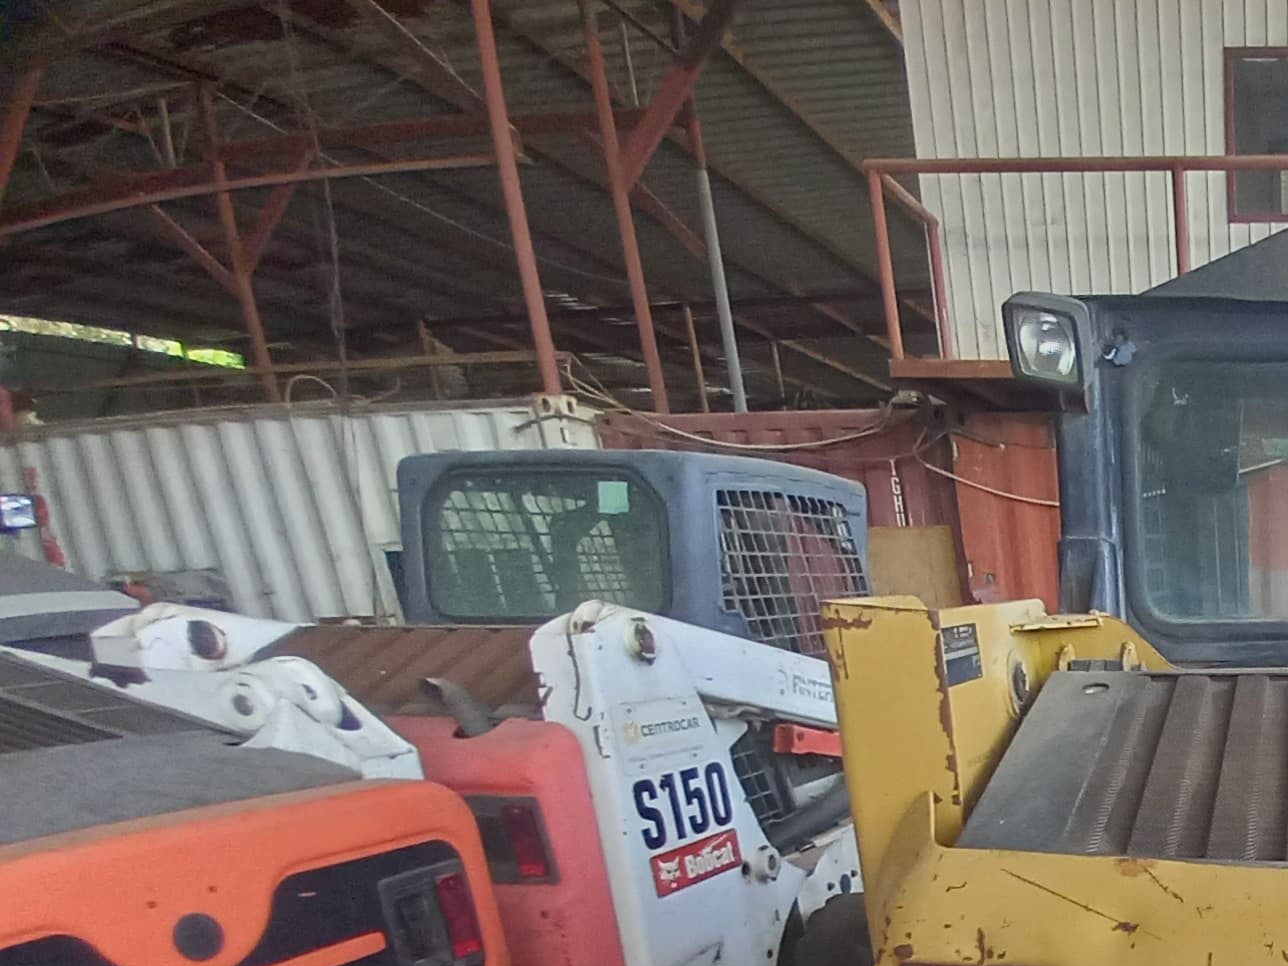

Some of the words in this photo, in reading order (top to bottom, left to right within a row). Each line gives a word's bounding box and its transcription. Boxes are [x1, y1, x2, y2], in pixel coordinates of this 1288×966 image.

[640, 716, 701, 737] CENTROCAR
[633, 761, 733, 850] S150
[685, 841, 735, 879] Bobcat
